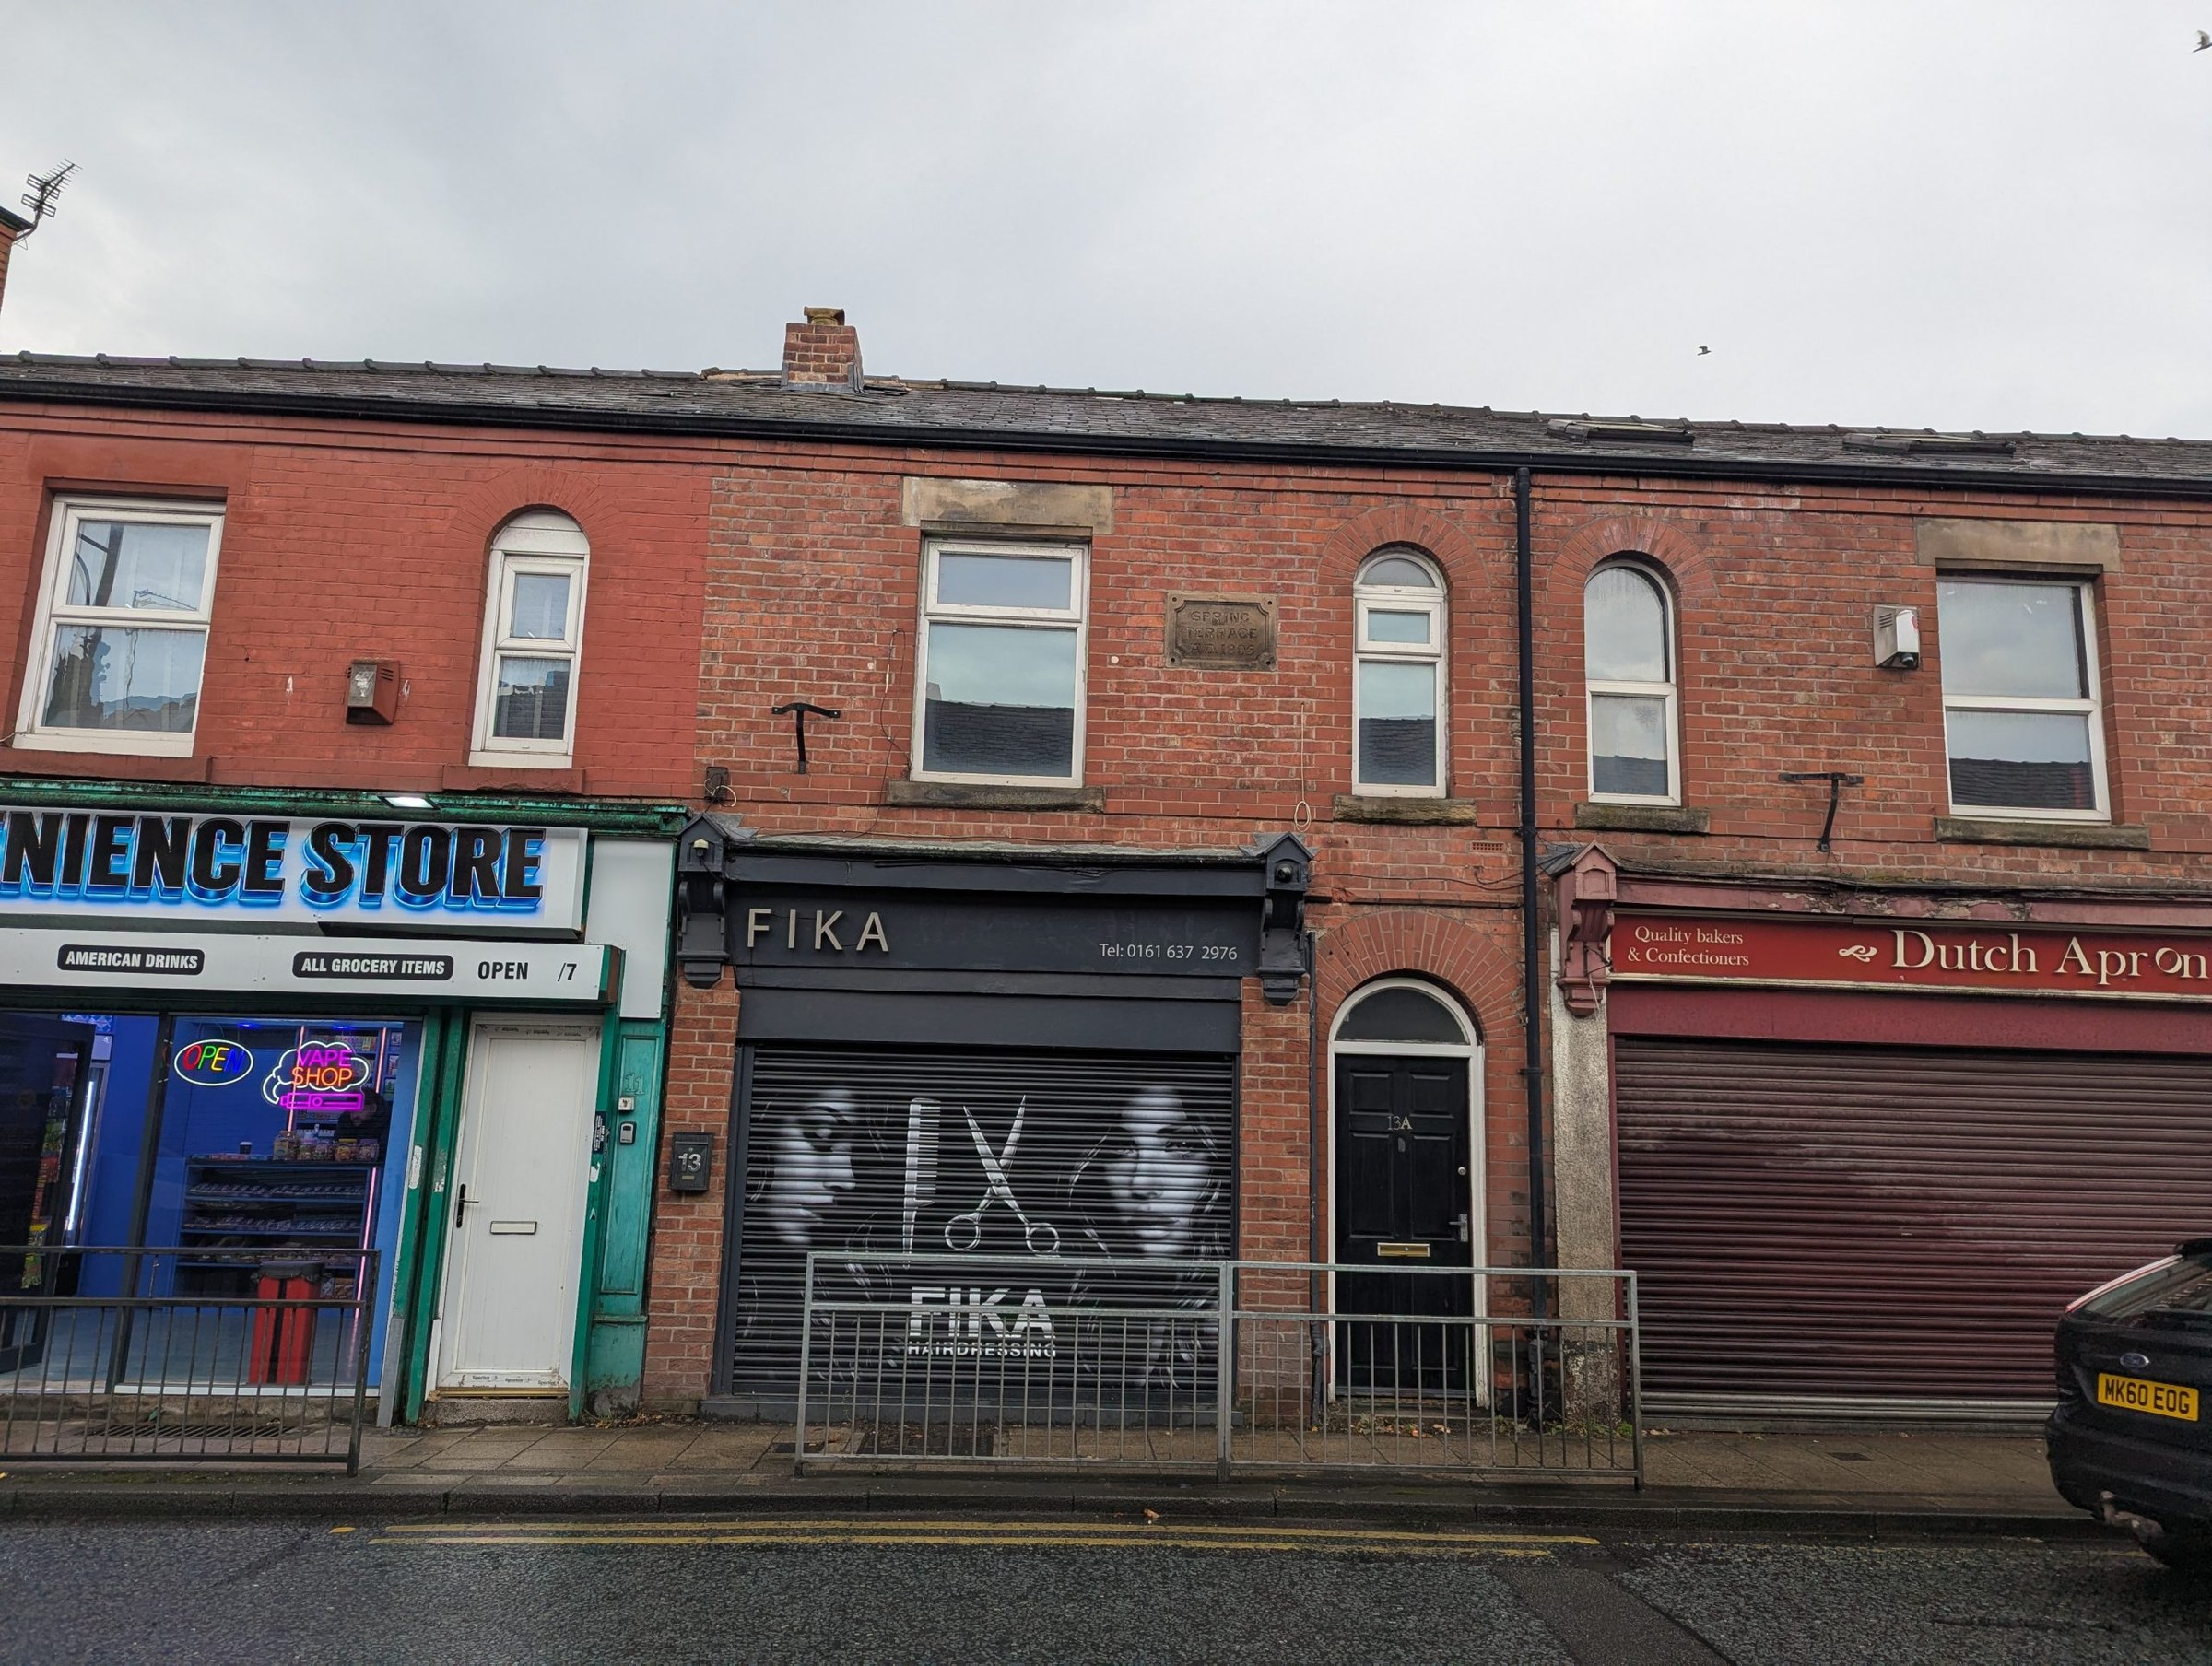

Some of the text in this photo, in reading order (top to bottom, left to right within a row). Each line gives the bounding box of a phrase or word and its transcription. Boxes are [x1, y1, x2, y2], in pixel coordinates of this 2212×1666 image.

[1191, 610, 1250, 624] SPRING
[1186, 628, 1258, 639] TERRACE
[0, 811, 545, 907] NIENCE STORE
[747, 909, 889, 952] FIKA
[1635, 925, 1744, 945] Quality bakers
[65, 950, 198, 969] AMERICAN DRINKS
[1100, 943, 1238, 960] Tel: 0161 637 2976
[1628, 946, 1749, 966] & Confectioners
[1891, 929, 2208, 986] Dutch Apron
[301, 957, 445, 976] ALL GROCERY ITEMS
[477, 961, 529, 980] OPEN
[183, 1044, 243, 1073] OPEN
[297, 1049, 353, 1067] VAPE
[291, 1067, 353, 1087] SHOP
[1387, 1116, 1412, 1131] 13A
[678, 1153, 701, 1172] 13
[909, 1286, 1055, 1338] FIKA
[907, 1341, 1056, 1357] HAIRDRESSING
[2105, 1378, 2191, 1414] MK60 EOG
